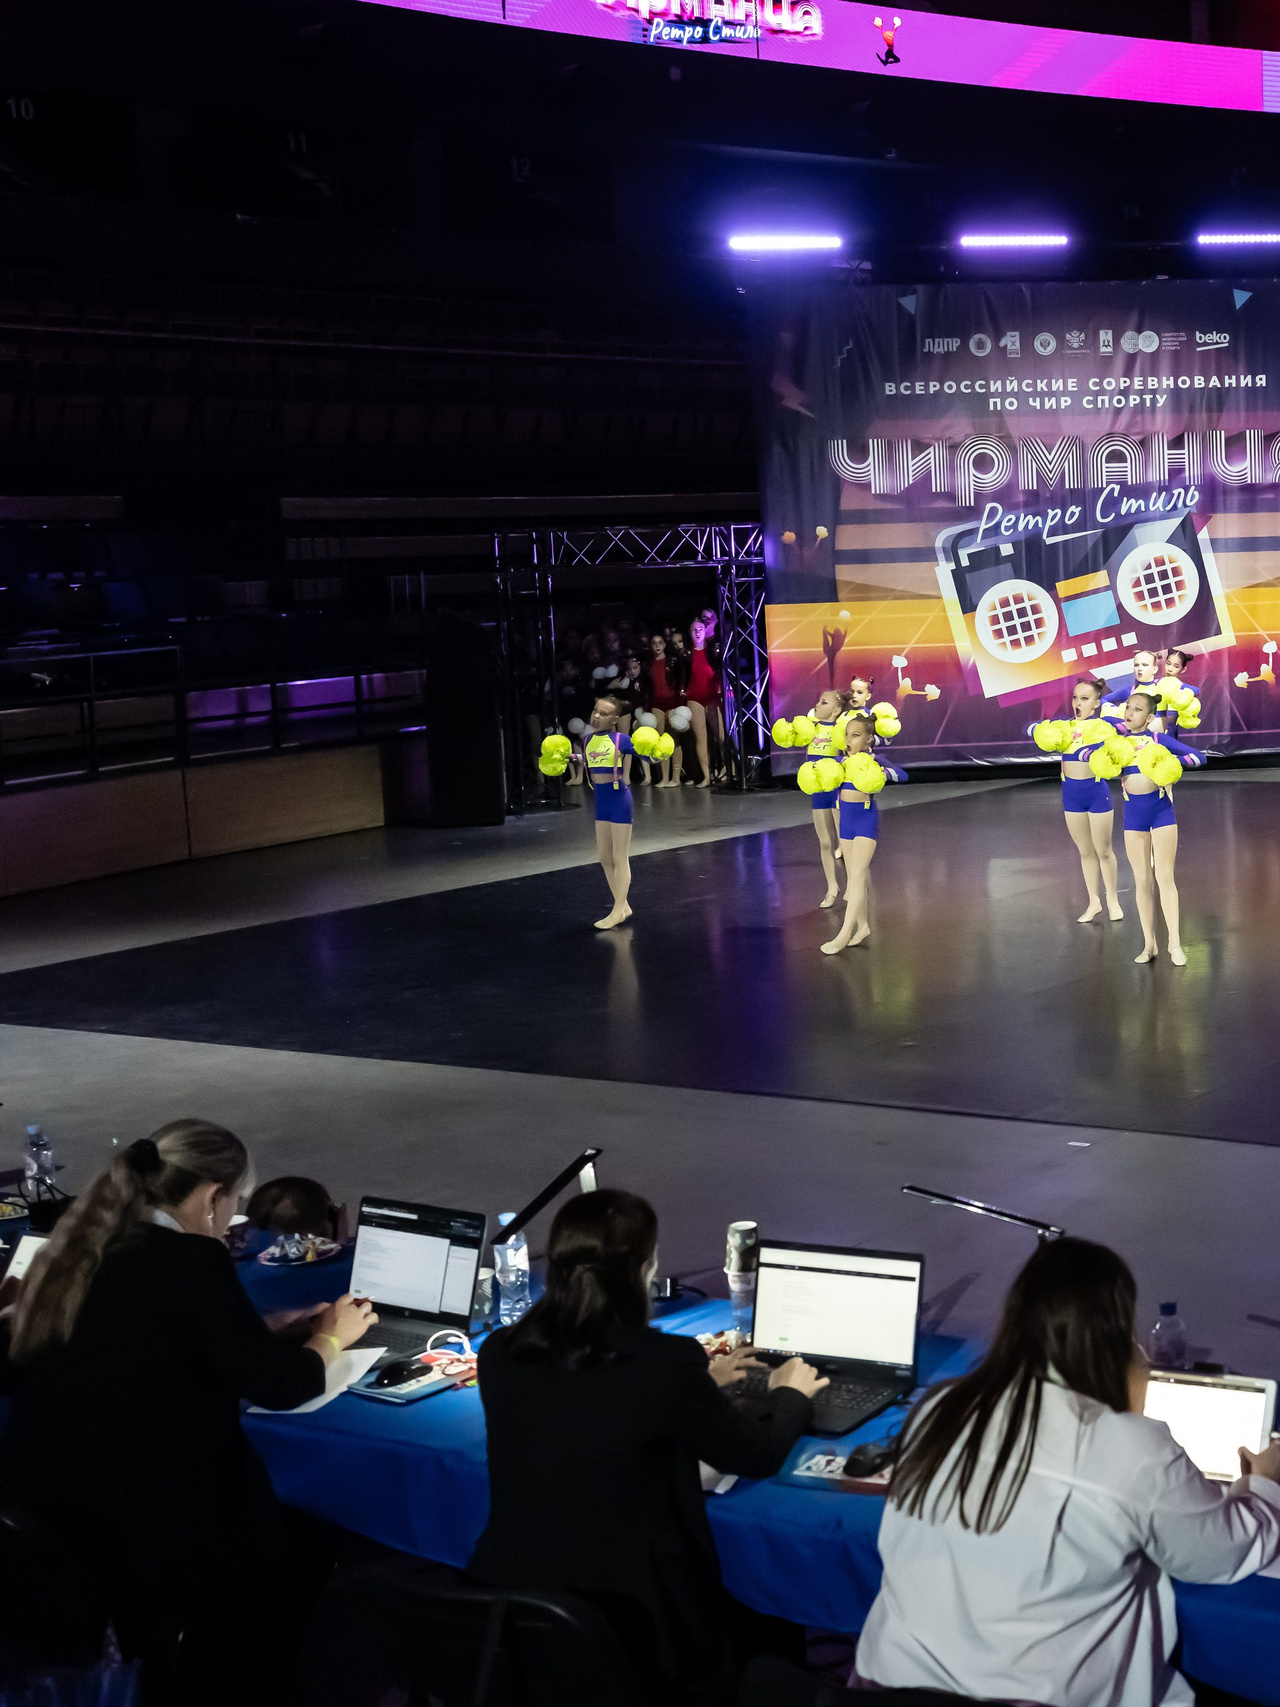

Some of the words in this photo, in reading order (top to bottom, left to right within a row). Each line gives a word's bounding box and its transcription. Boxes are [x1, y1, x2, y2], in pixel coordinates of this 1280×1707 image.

[649, 17, 702, 45] Ретро
[6, 96, 35, 122] 10
[285, 130, 307, 153] 11
[923, 337, 961, 354] ЛДПР
[1196, 331, 1230, 343] beko
[884, 375, 1079, 396] ВСЕРОССИЙСКИЕ
[1088, 373, 1268, 391] СОРЕВНОВАНИЯ
[989, 397, 1018, 411] ПО
[1029, 396, 1072, 410] ЧИР
[1082, 394, 1168, 409] СПОРТУ
[977, 501, 1081, 545] Ретро
[1095, 483, 1200, 524] Стиль
